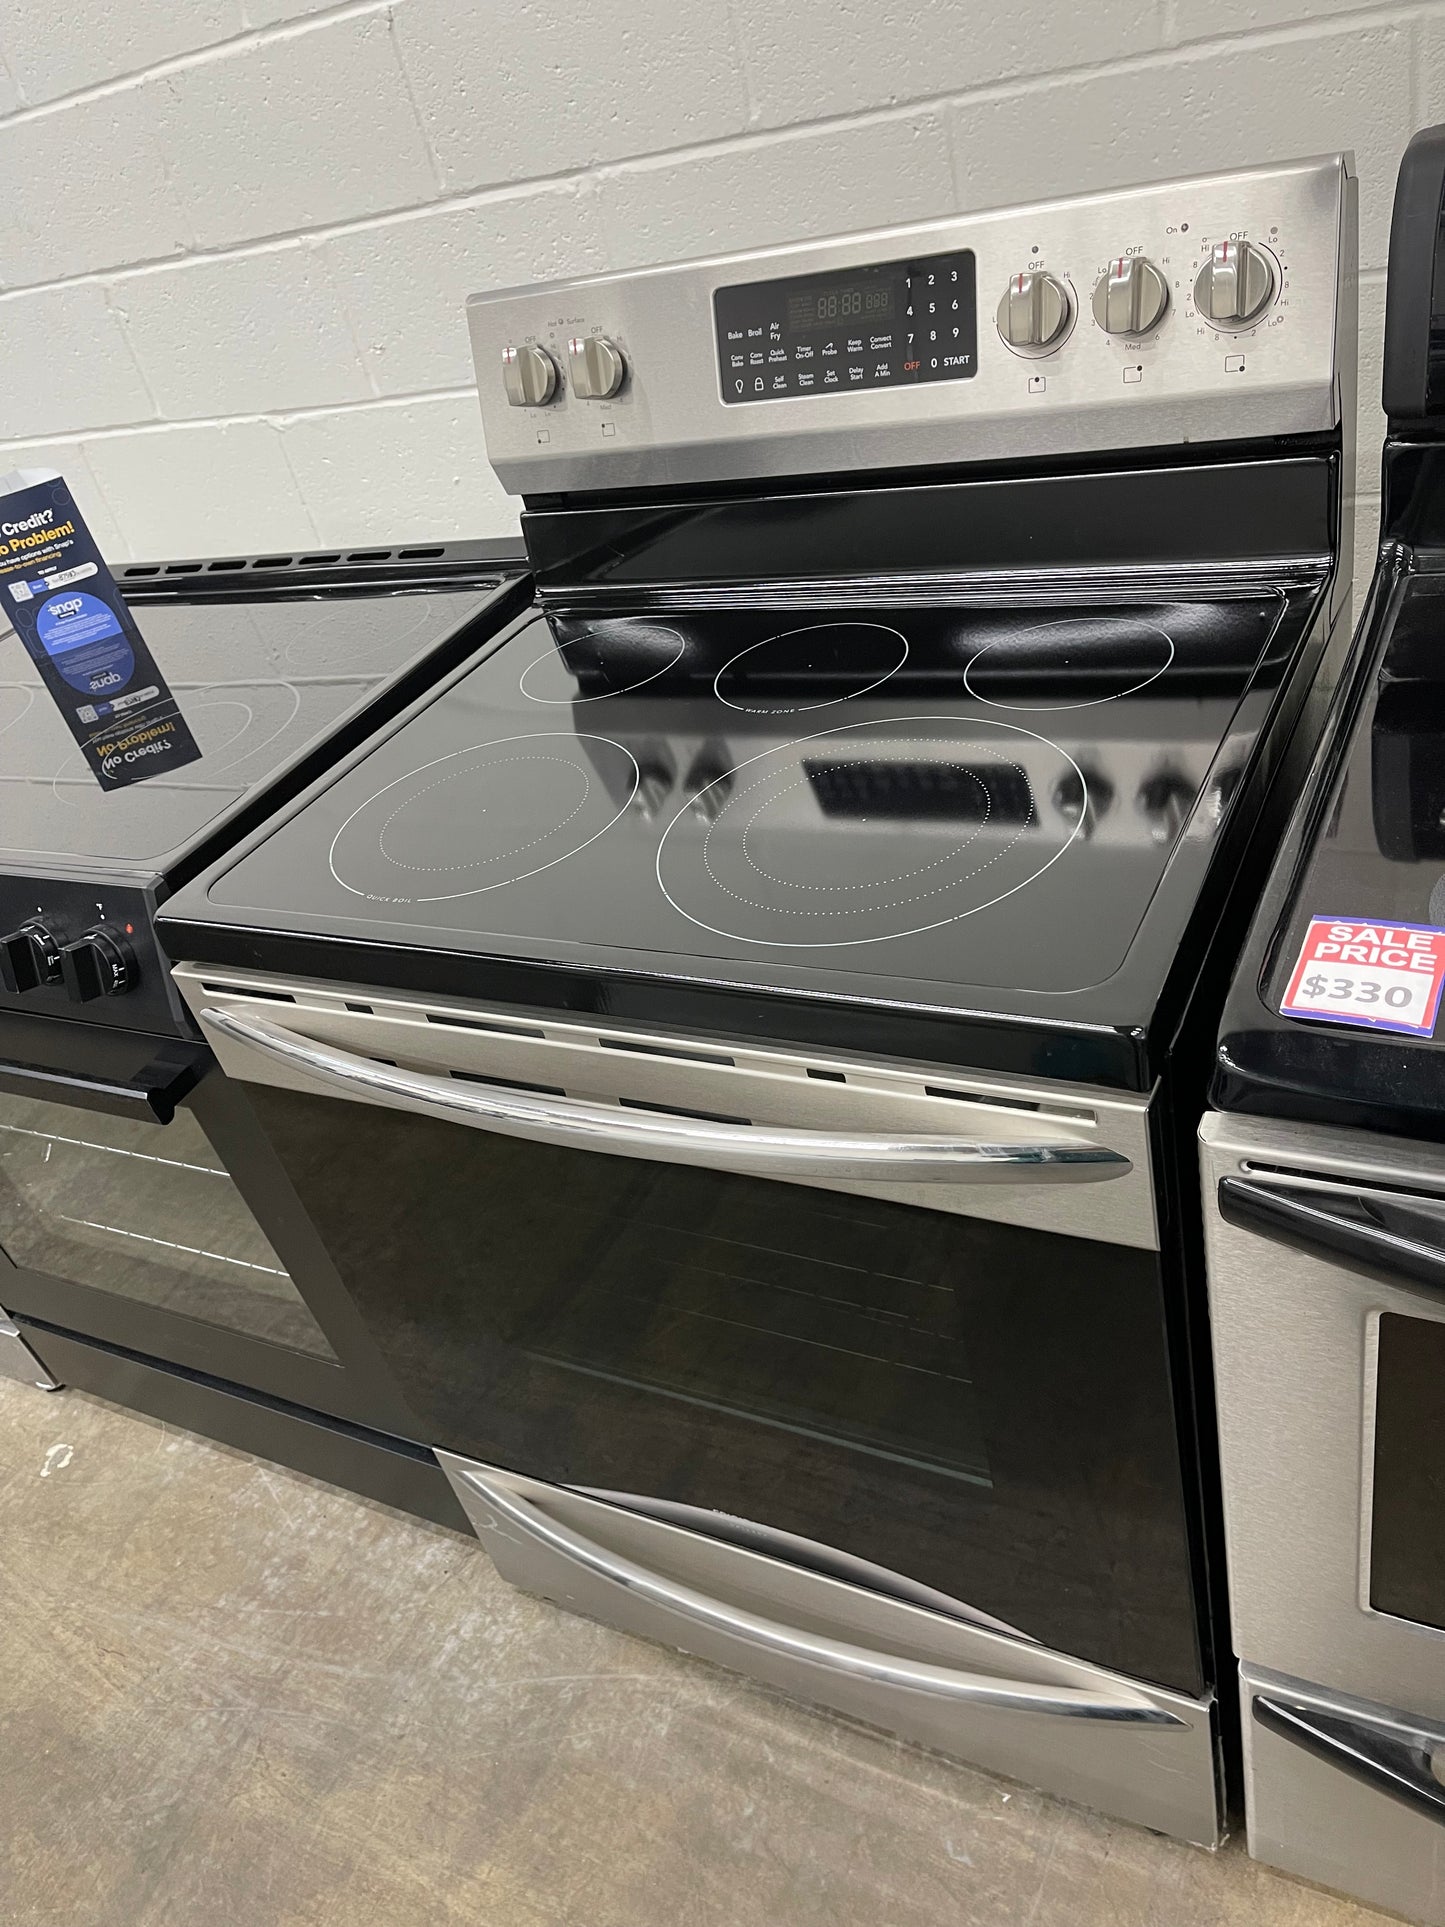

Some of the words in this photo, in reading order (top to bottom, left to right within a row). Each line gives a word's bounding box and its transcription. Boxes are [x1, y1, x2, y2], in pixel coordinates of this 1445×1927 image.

[1166, 226, 1178, 235] On
[1229, 231, 1249, 241] OFF
[1268, 236, 1278, 244] Lo
[1125, 246, 1144, 256] OFF
[1201, 244, 1210, 252] Hi
[1280, 249, 1285, 257] 2
[1028, 260, 1045, 270] OFF
[1193, 261, 1198, 269] 8
[906, 278, 911, 289] 1
[928, 274, 935, 286] 2
[951, 270, 958, 282] 3
[1175, 280, 1180, 288] 8
[1284, 281, 1290, 289] 8
[1089, 292, 1094, 300] 2
[1186, 293, 1192, 301] 2
[1280, 299, 1289, 307] Hi
[906, 305, 914, 317] 4
[929, 302, 936, 314] 5
[952, 299, 959, 310] 6
[1171, 308, 1177, 317] 7
[770, 321, 780, 330] Air
[591, 326, 603, 334] OFF
[727, 331, 743, 340] Bake
[747, 327, 762, 337] Broil
[1196, 327, 1205, 335] Hi
[1251, 328, 1257, 336] 2
[770, 332, 781, 341] Fry
[907, 333, 914, 344] 7
[929, 330, 937, 341] 8
[952, 327, 960, 338] 9
[1214, 333, 1220, 341] 8
[847, 339, 862, 347] Keep
[870, 342, 892, 350] Convert
[1124, 342, 1141, 351] Med
[770, 348, 785, 356] Quick
[795, 351, 814, 360] On-Off
[731, 360, 744, 368] Bake
[904, 361, 920, 371] OFF
[931, 358, 938, 369] 0
[943, 355, 970, 367] START
[848, 366, 864, 374] Delay
[774, 375, 785, 383] Self
[850, 373, 864, 381] Start
[772, 382, 788, 390] Clean
[1, 508, 54, 536] Credit?
[0, 545, 10, 556] o
[8, 520, 75, 552] Problem!
[20, 550, 43, 561] options
[48, 598, 82, 616] snap
[366, 894, 391, 902] QUICK
[1327, 925, 1434, 951] SALE
[1313, 942, 1438, 972] PRICE
[1302, 974, 1413, 1008] $330
